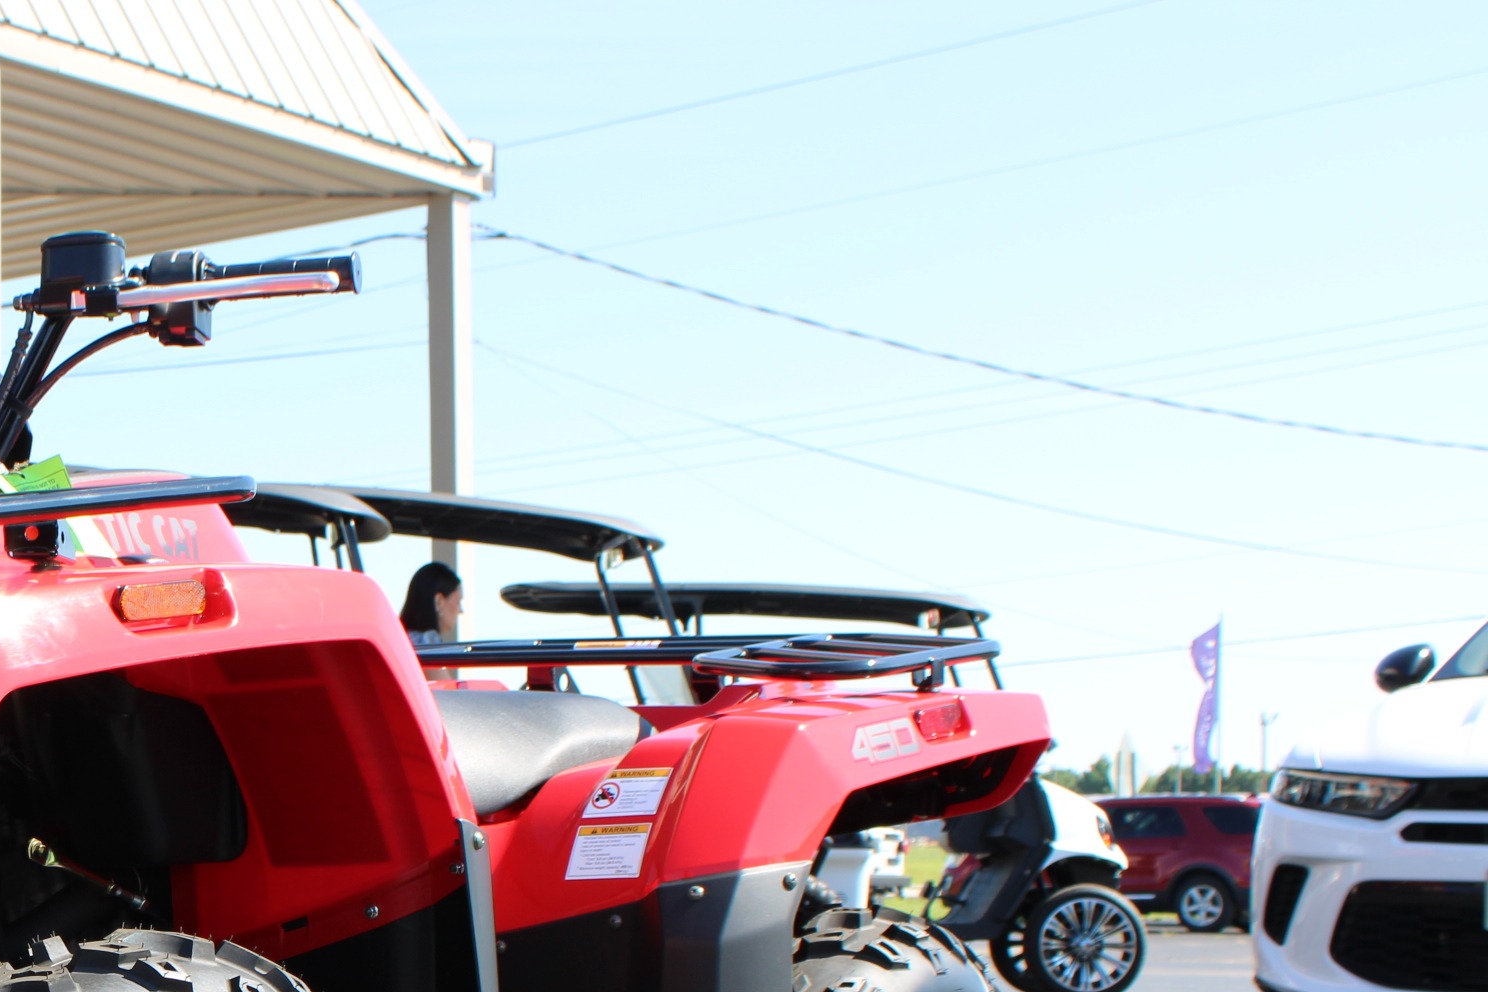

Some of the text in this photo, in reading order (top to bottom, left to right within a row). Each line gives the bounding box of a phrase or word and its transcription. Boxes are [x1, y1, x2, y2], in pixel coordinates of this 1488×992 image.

[152, 515, 199, 561] CAT
[851, 717, 921, 765] 450
[619, 769, 656, 777] WARNING
[600, 825, 639, 834] WARNING
